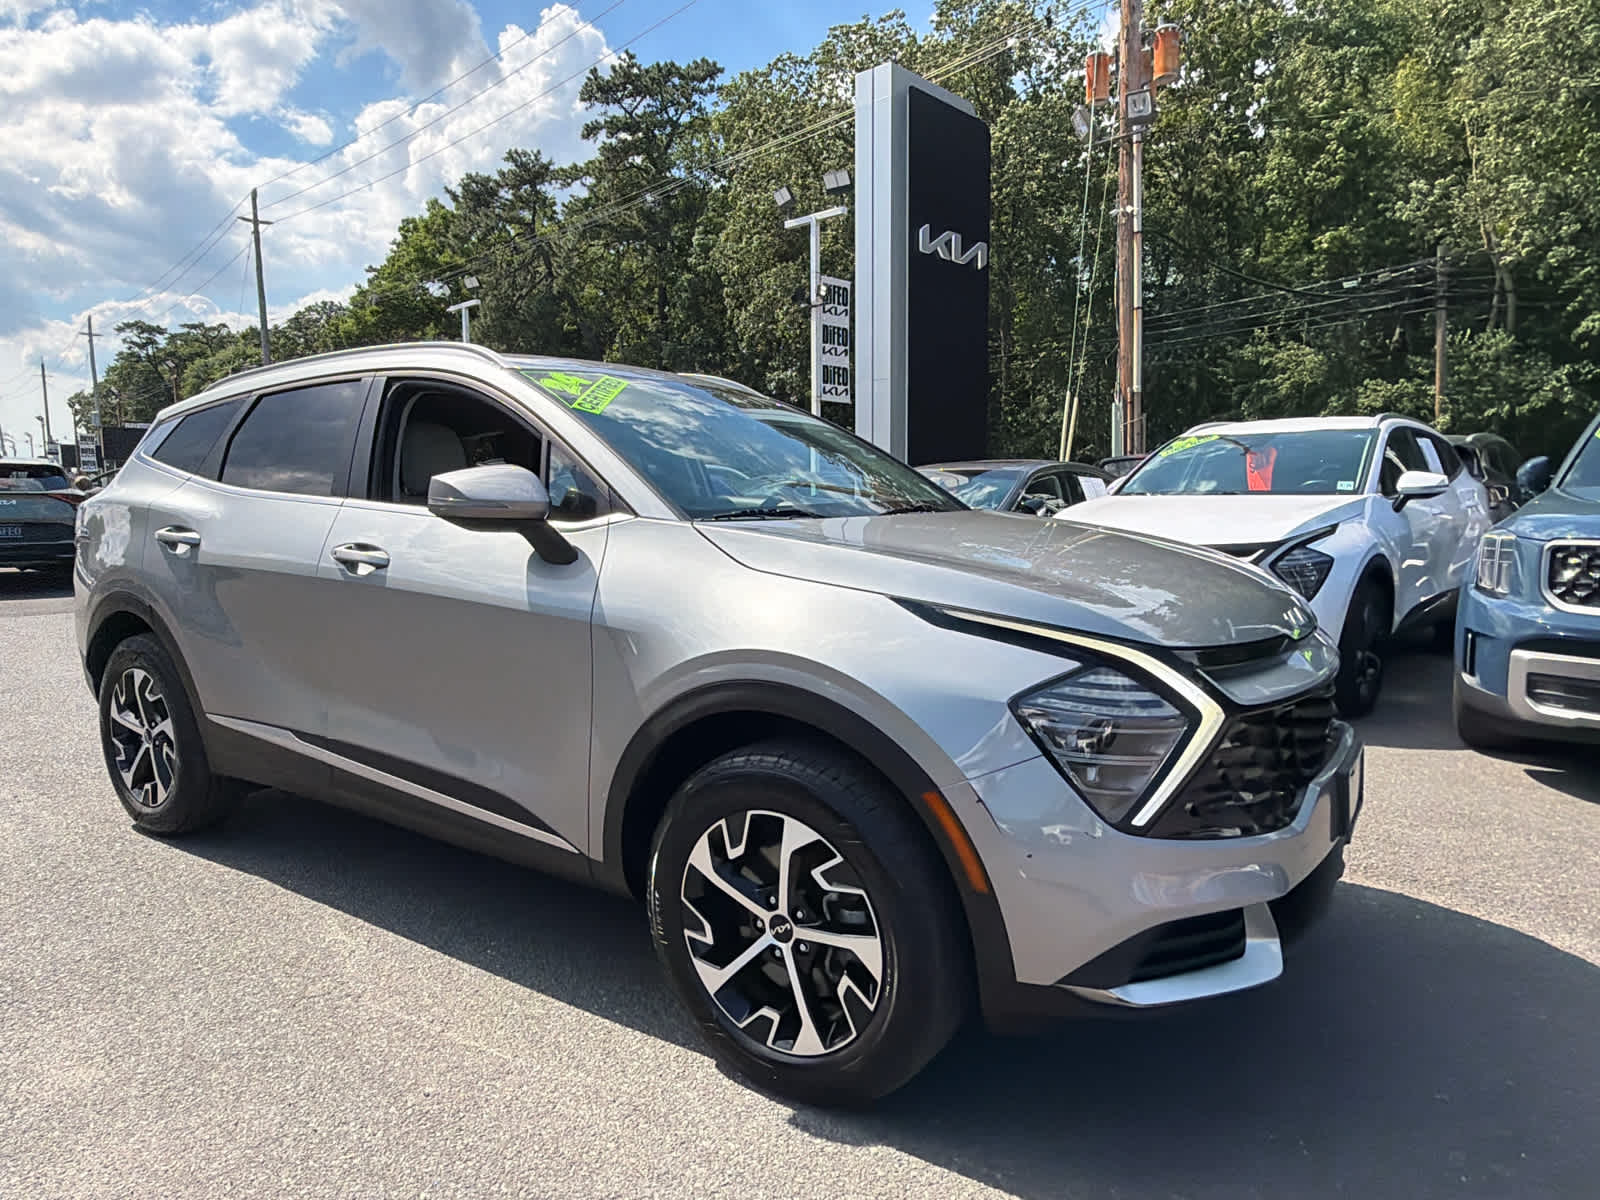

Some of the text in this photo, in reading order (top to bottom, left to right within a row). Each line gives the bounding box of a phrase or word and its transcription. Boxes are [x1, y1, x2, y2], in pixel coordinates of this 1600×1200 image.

[919, 223, 987, 270] KIA
[823, 306, 848, 316] KIA
[823, 345, 848, 357] KIA
[823, 386, 848, 396] KIA
